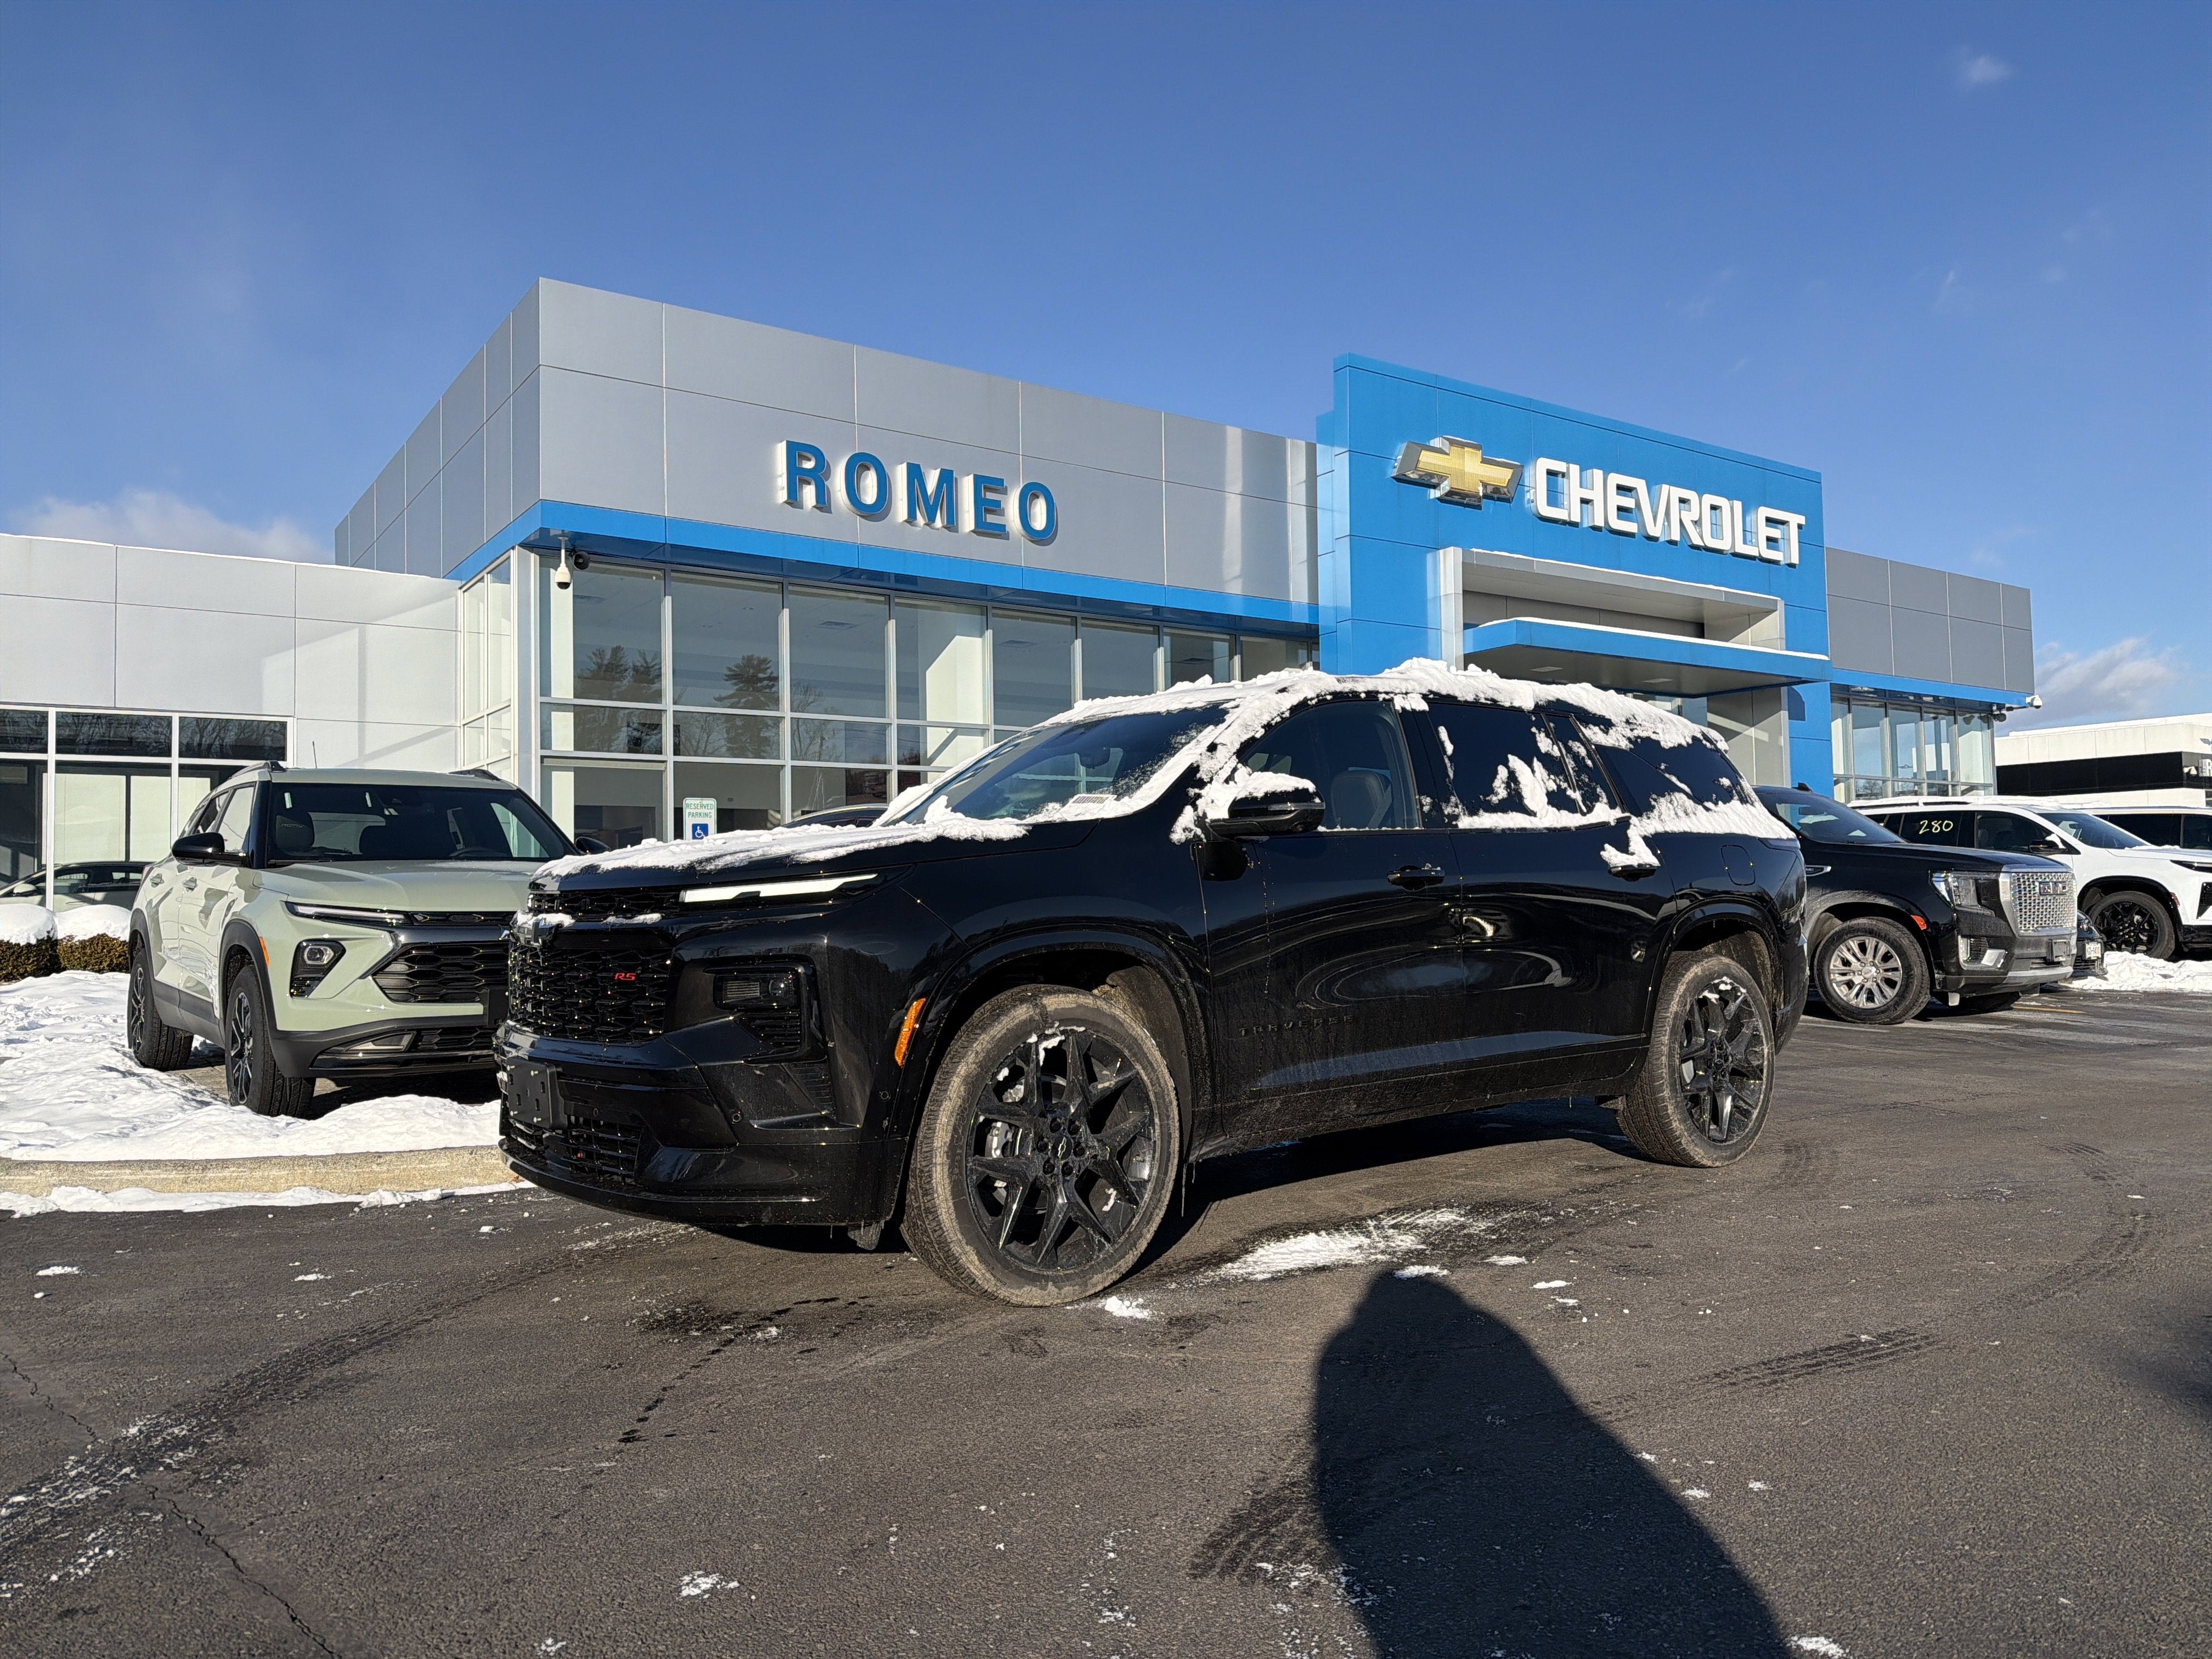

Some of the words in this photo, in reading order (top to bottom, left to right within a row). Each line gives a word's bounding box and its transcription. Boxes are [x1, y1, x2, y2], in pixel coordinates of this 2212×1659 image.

[783, 439, 1057, 541] ROMEO
[1534, 457, 1805, 565] CHEVROLET
[1918, 820, 1954, 834] 280
